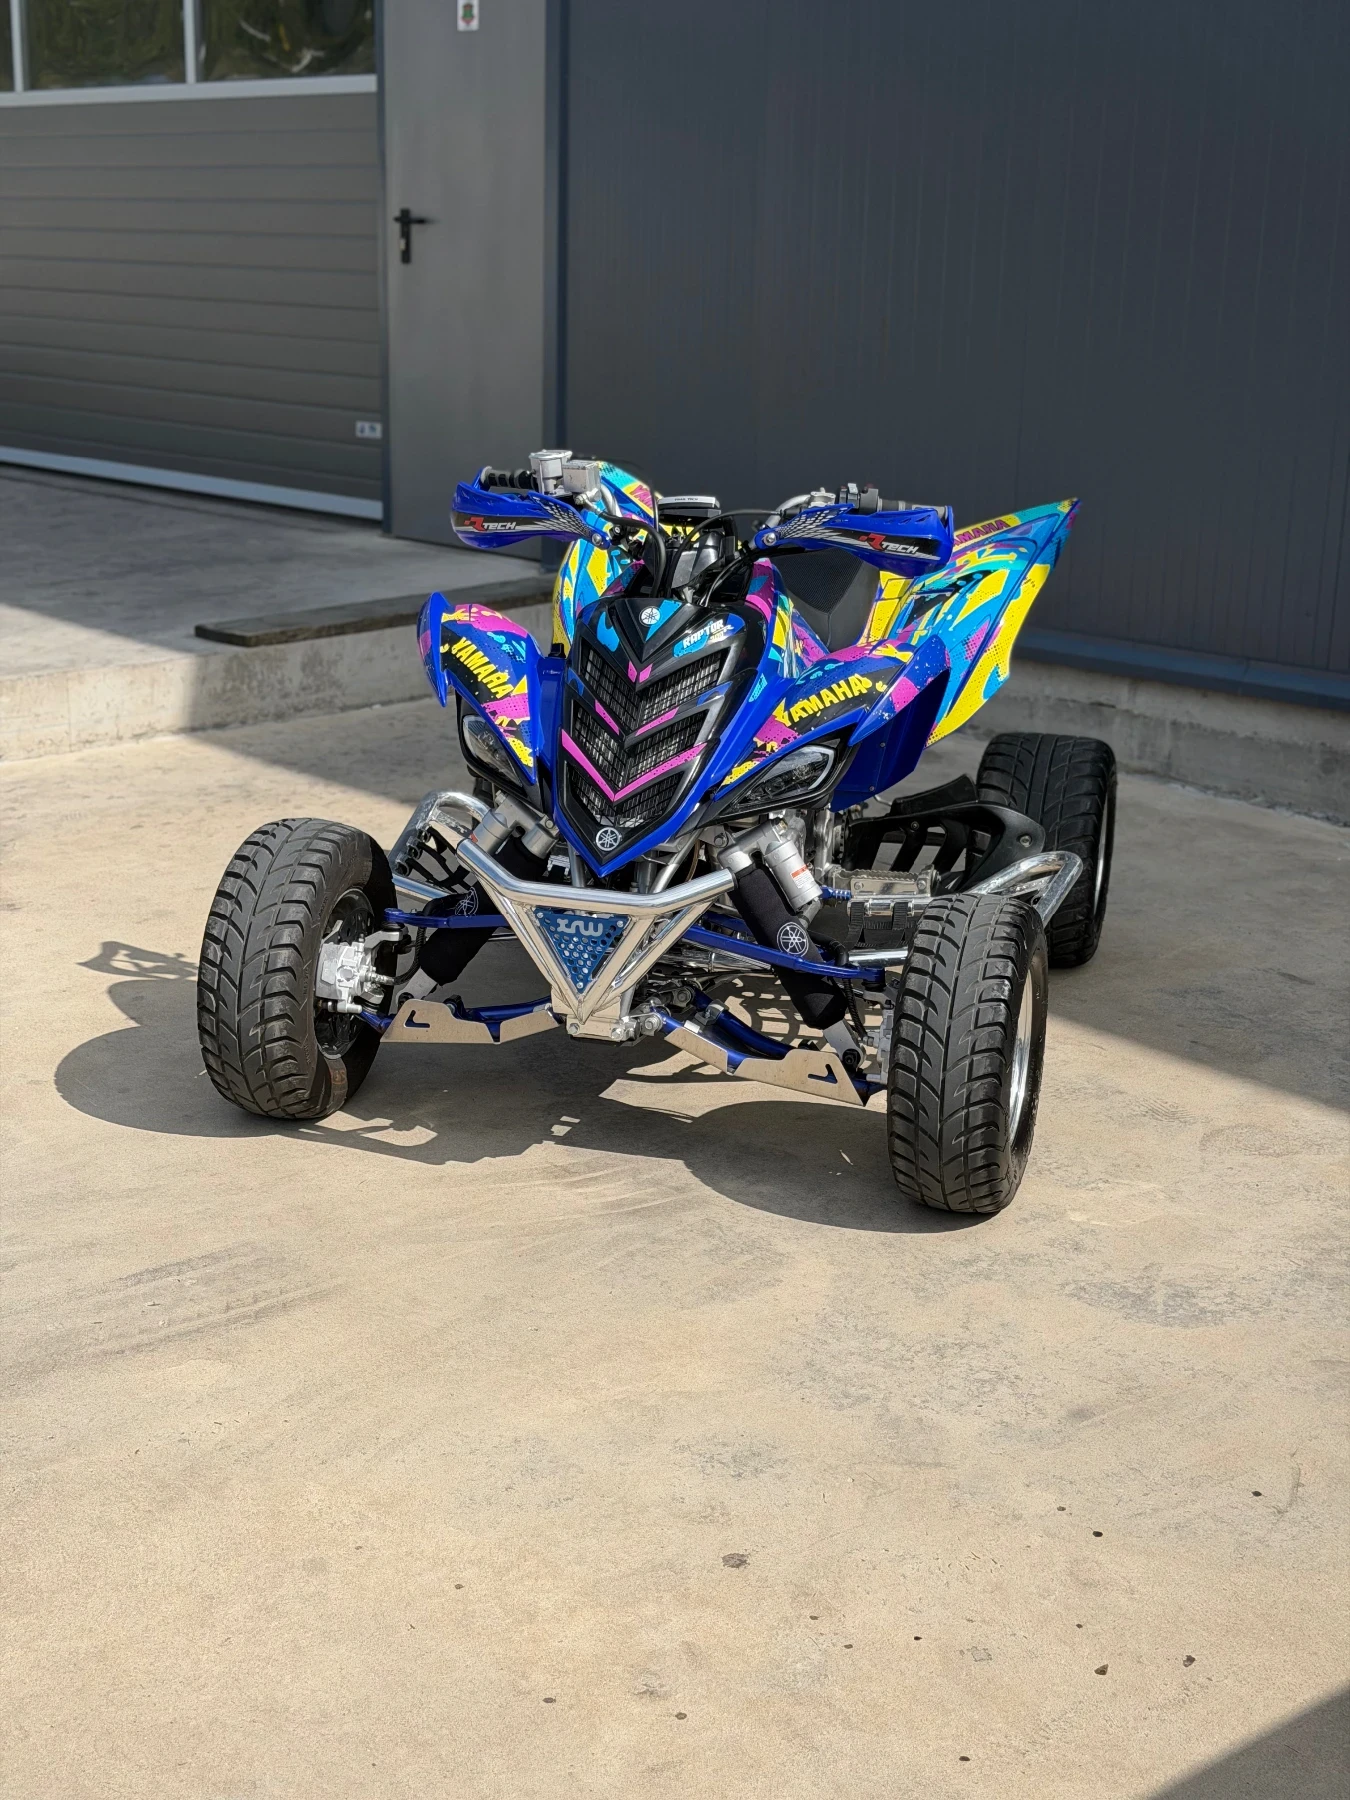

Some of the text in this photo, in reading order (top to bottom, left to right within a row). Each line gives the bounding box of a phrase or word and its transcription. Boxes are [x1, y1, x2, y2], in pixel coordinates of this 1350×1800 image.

[682, 618, 724, 649] RAPTOR
[451, 636, 514, 700] YAMAHA
[772, 673, 873, 728] YAMAHA
